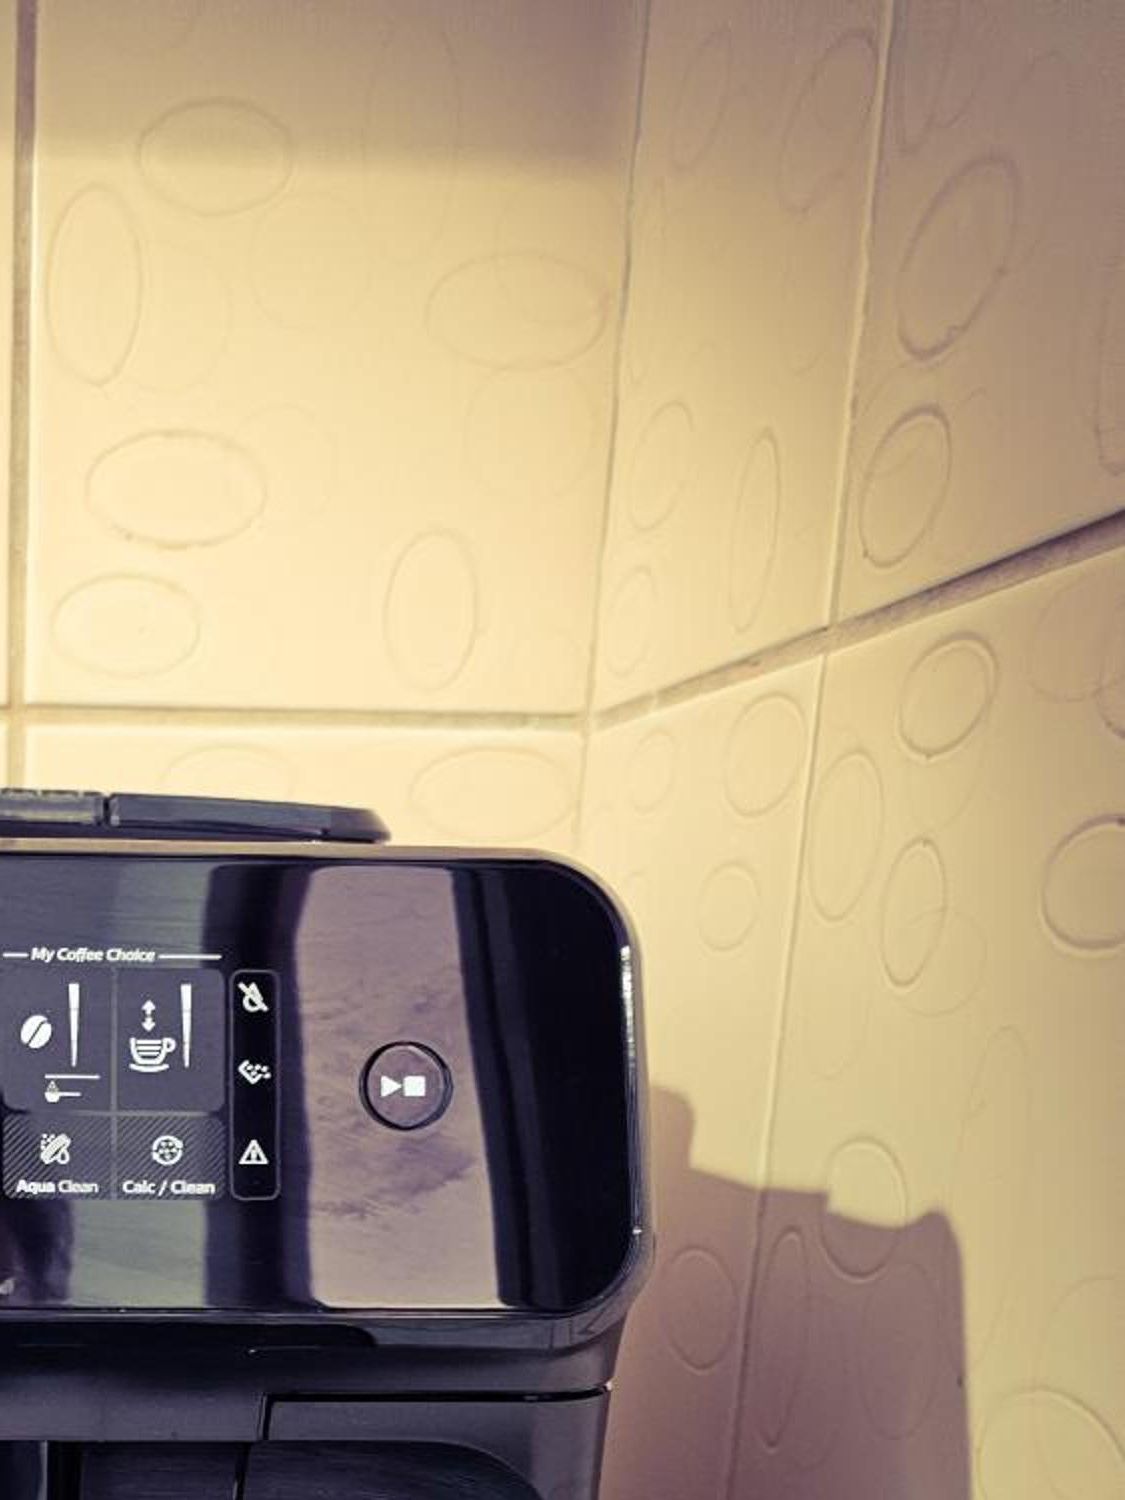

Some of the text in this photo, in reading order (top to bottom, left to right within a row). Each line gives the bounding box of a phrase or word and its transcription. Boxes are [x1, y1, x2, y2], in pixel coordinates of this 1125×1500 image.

[31, 947, 156, 964] My Coffee Choice
[16, 1179, 98, 1195] Aqua Clean
[122, 1179, 156, 1194] Calc
[171, 1179, 216, 1194] Clean
